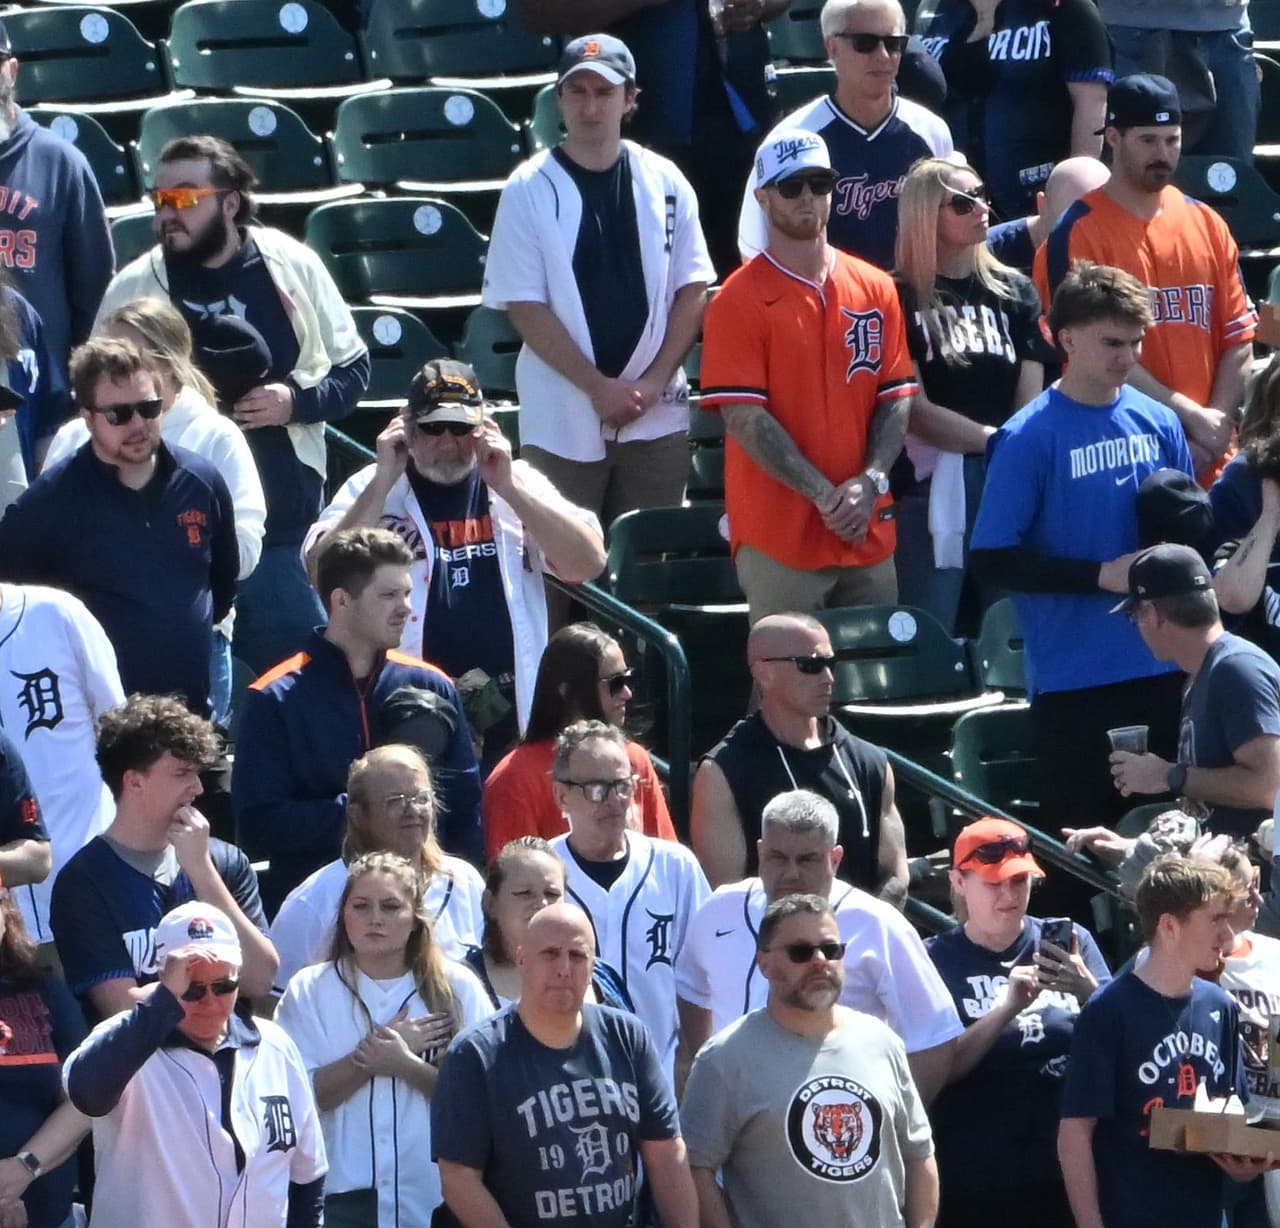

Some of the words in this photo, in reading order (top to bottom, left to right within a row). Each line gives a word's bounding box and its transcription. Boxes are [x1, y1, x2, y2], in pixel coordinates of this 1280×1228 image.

[841, 306, 885, 384] D
[1070, 437, 1128, 479] MOTOR
[1128, 433, 1160, 465] CITY
[451, 567, 470, 588] D
[11, 667, 65, 742] D
[1139, 1031, 1226, 1085] OCTOBER
[1176, 1062, 1198, 1099] D
[517, 1077, 640, 1139] TIGERS
[798, 1076, 874, 1104] DETROIT
[261, 1095, 297, 1154] D
[568, 1121, 614, 1184] D
[809, 1154, 875, 1178] TIGERS
[534, 1179, 638, 1220] DETROI
